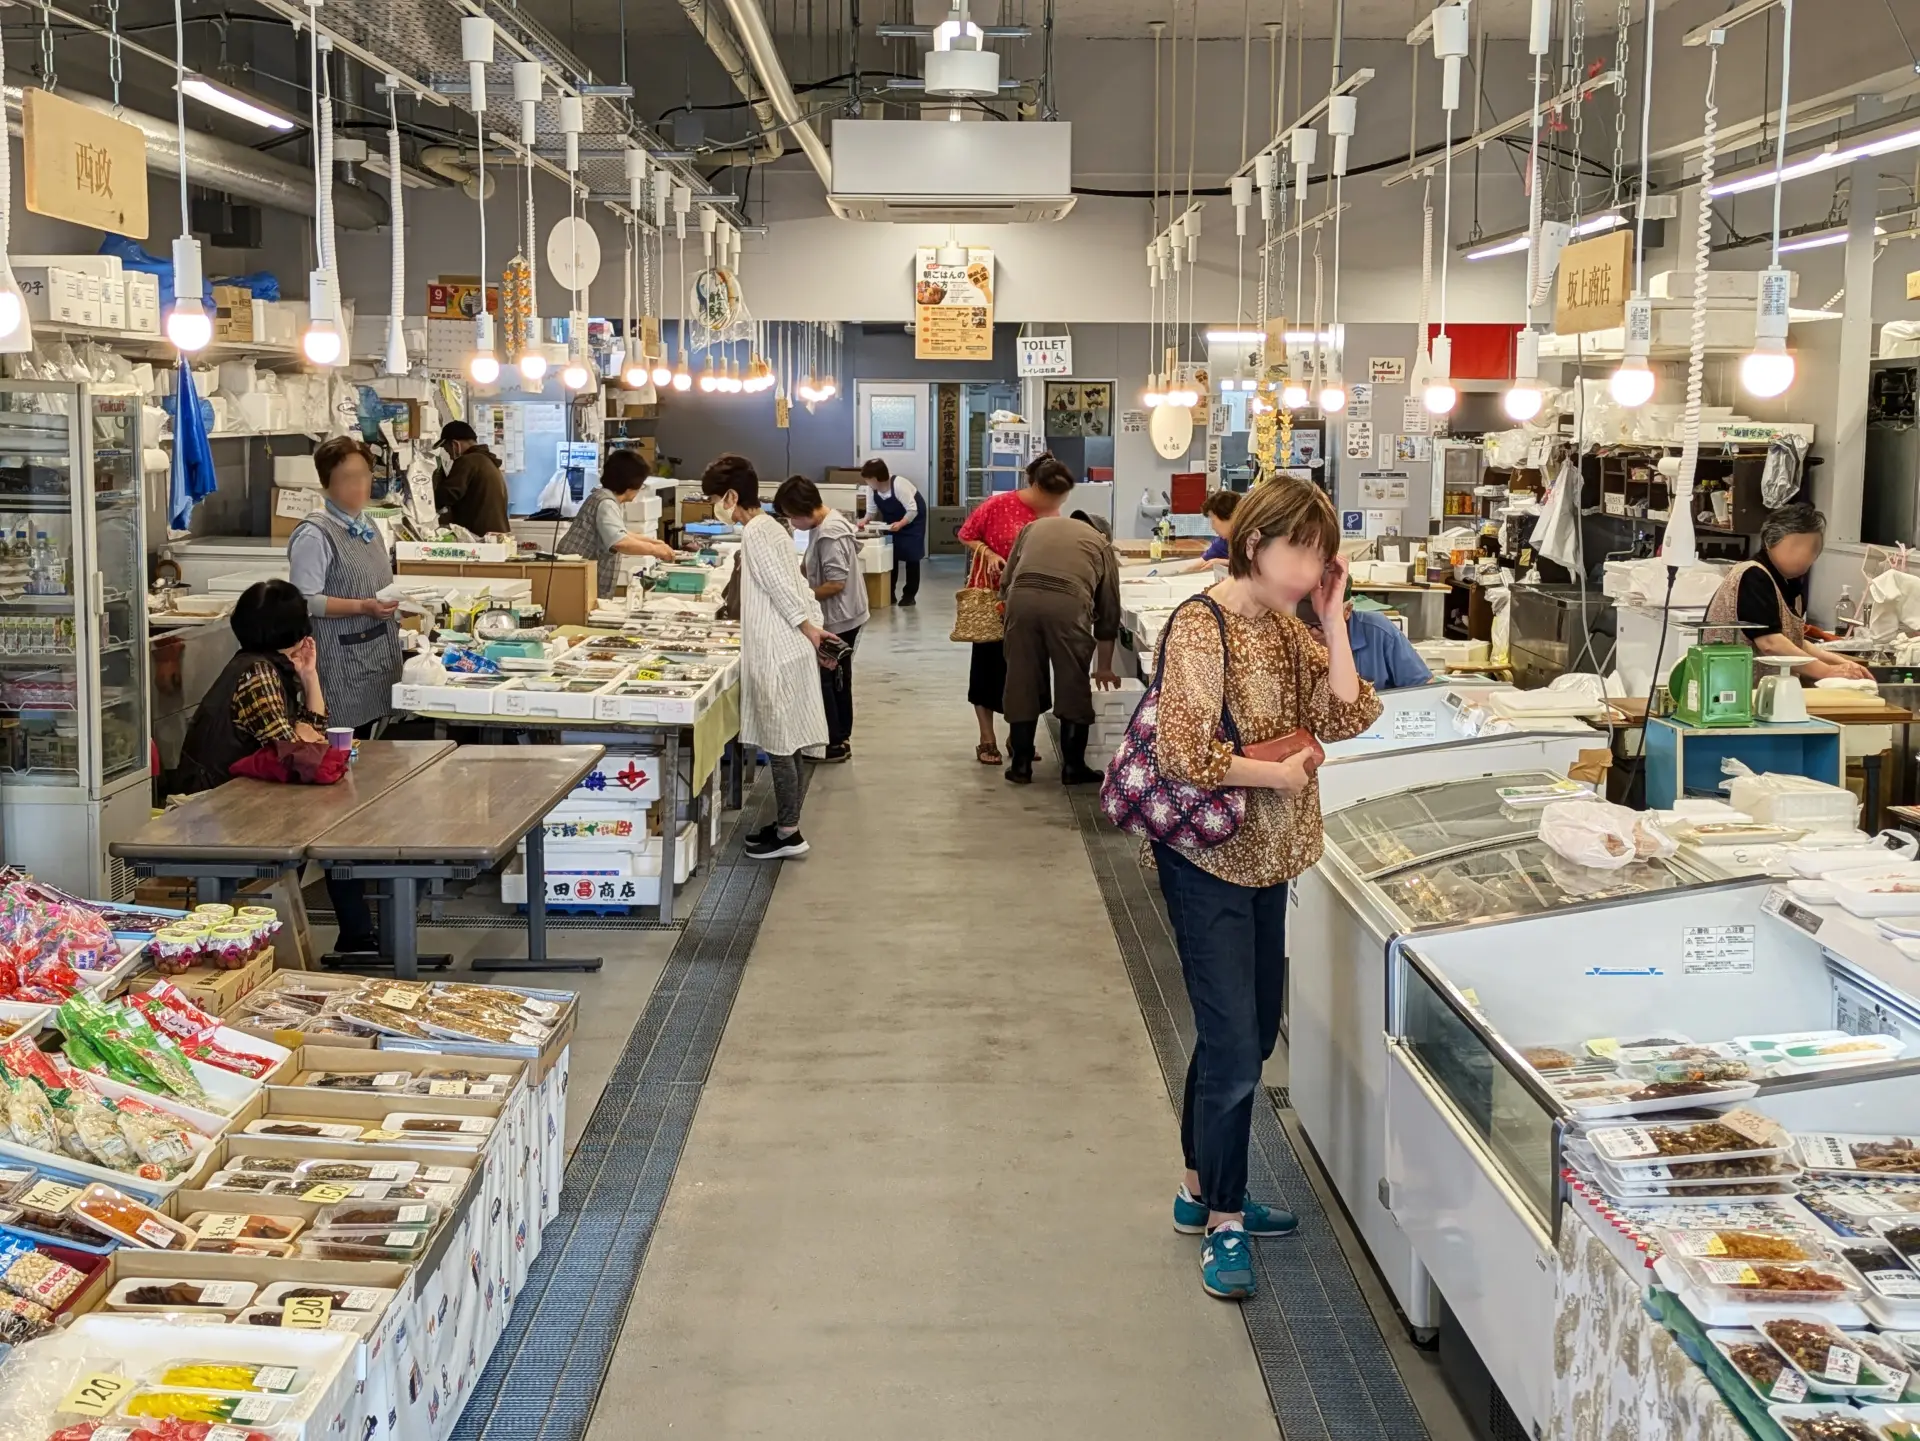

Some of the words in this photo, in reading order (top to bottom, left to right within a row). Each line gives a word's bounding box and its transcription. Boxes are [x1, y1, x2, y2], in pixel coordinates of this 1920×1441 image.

[923, 271, 965, 279] 朝ごはんの
[924, 280, 948, 288] 食べ方
[1567, 263, 1611, 309] 坂上商店
[434, 289, 443, 300] 9
[1022, 340, 1066, 350] TOILET
[1372, 361, 1394, 369] トイレ
[598, 881, 636, 898] 商店
[313, 1184, 349, 1200] 150
[292, 1299, 325, 1324] 130
[74, 1378, 121, 1408] 120
